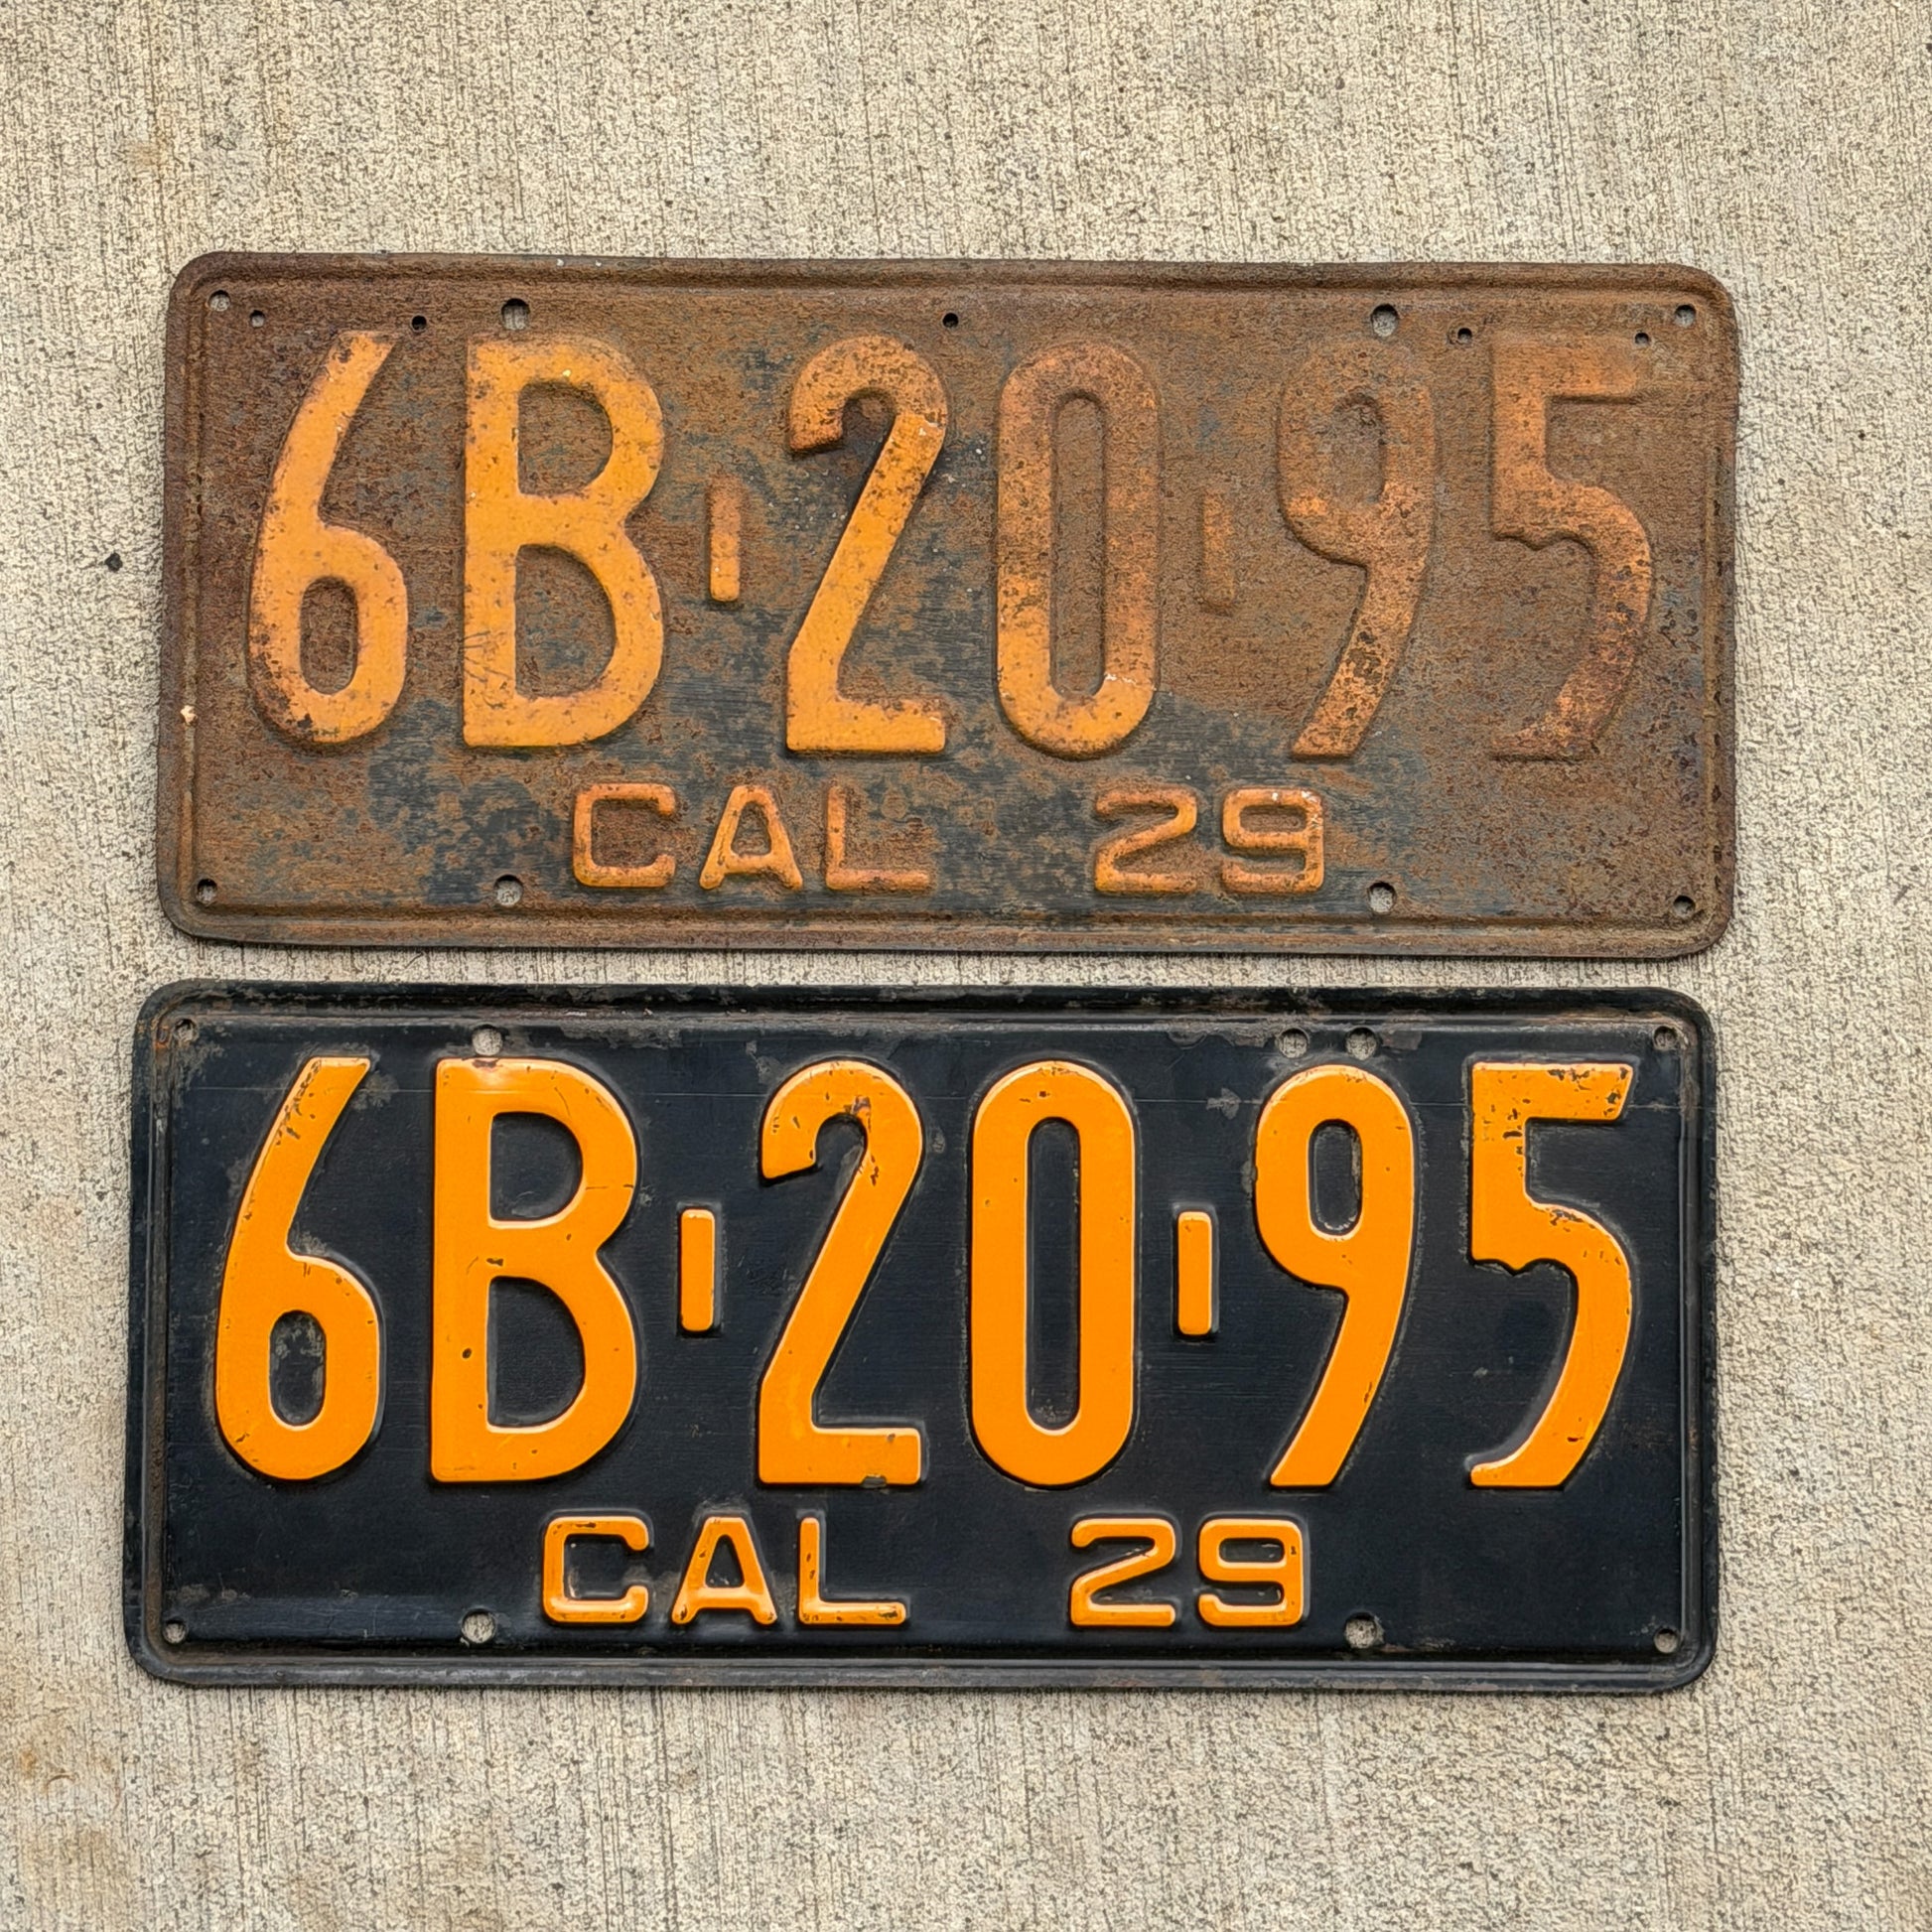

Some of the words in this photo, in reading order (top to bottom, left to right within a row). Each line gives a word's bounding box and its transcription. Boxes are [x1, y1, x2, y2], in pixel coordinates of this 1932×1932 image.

[573, 784, 930, 889] CAL
[1094, 787, 1324, 893] 29
[543, 1516, 907, 1625] CAL
[1070, 1518, 1304, 1625] 29
